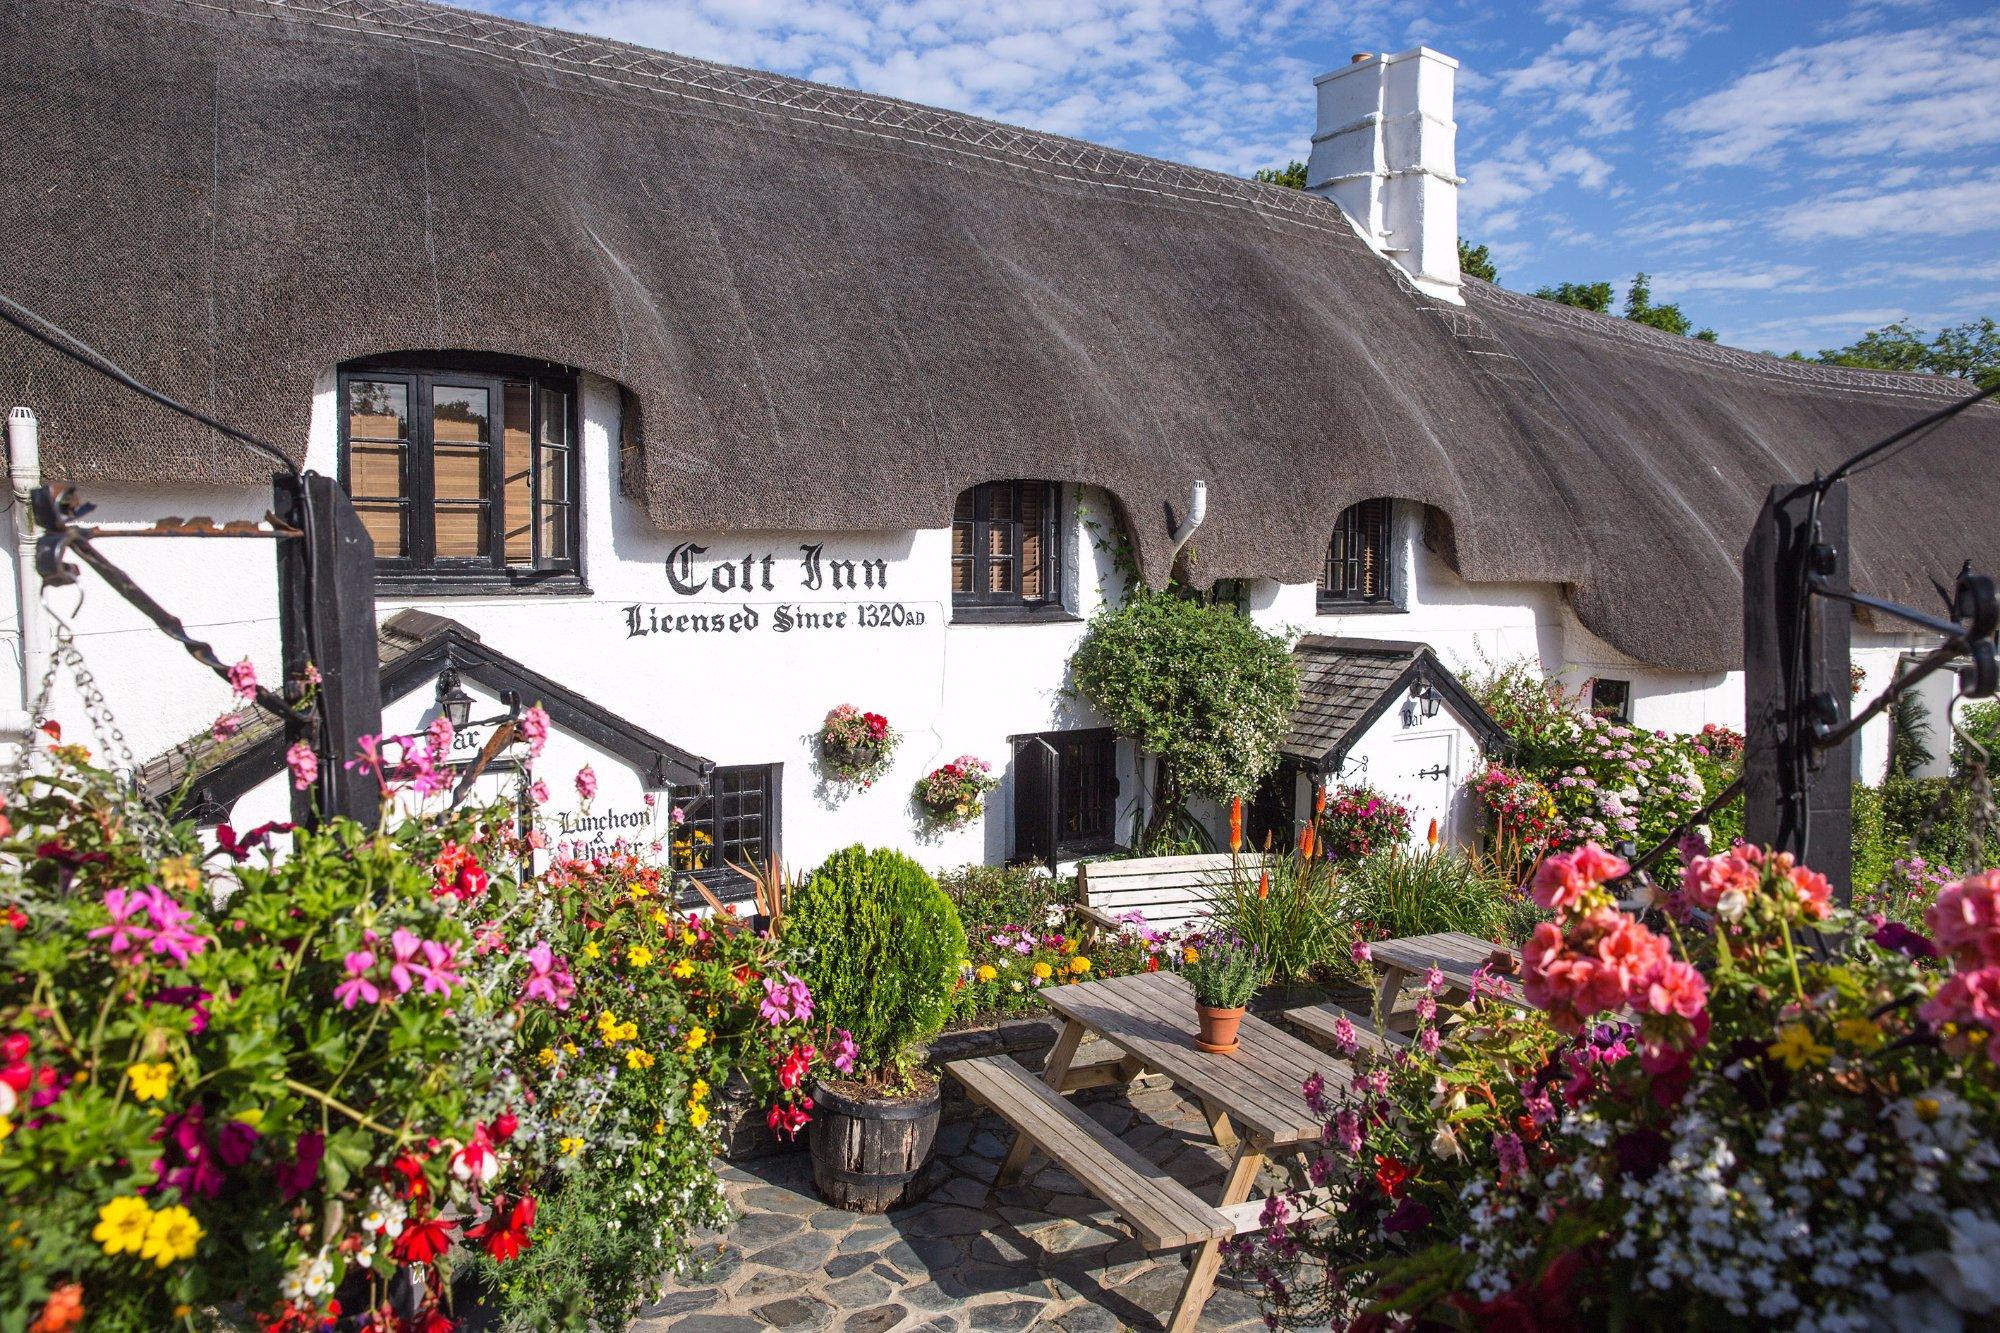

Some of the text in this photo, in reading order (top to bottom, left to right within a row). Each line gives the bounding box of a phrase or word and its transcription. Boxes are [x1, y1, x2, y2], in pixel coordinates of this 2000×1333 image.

[665, 541, 888, 596] Cott Inn
[621, 603, 759, 640] Licensed
[772, 602, 847, 633] Since
[558, 807, 651, 837] Luncheon
[594, 831, 606, 844] &
